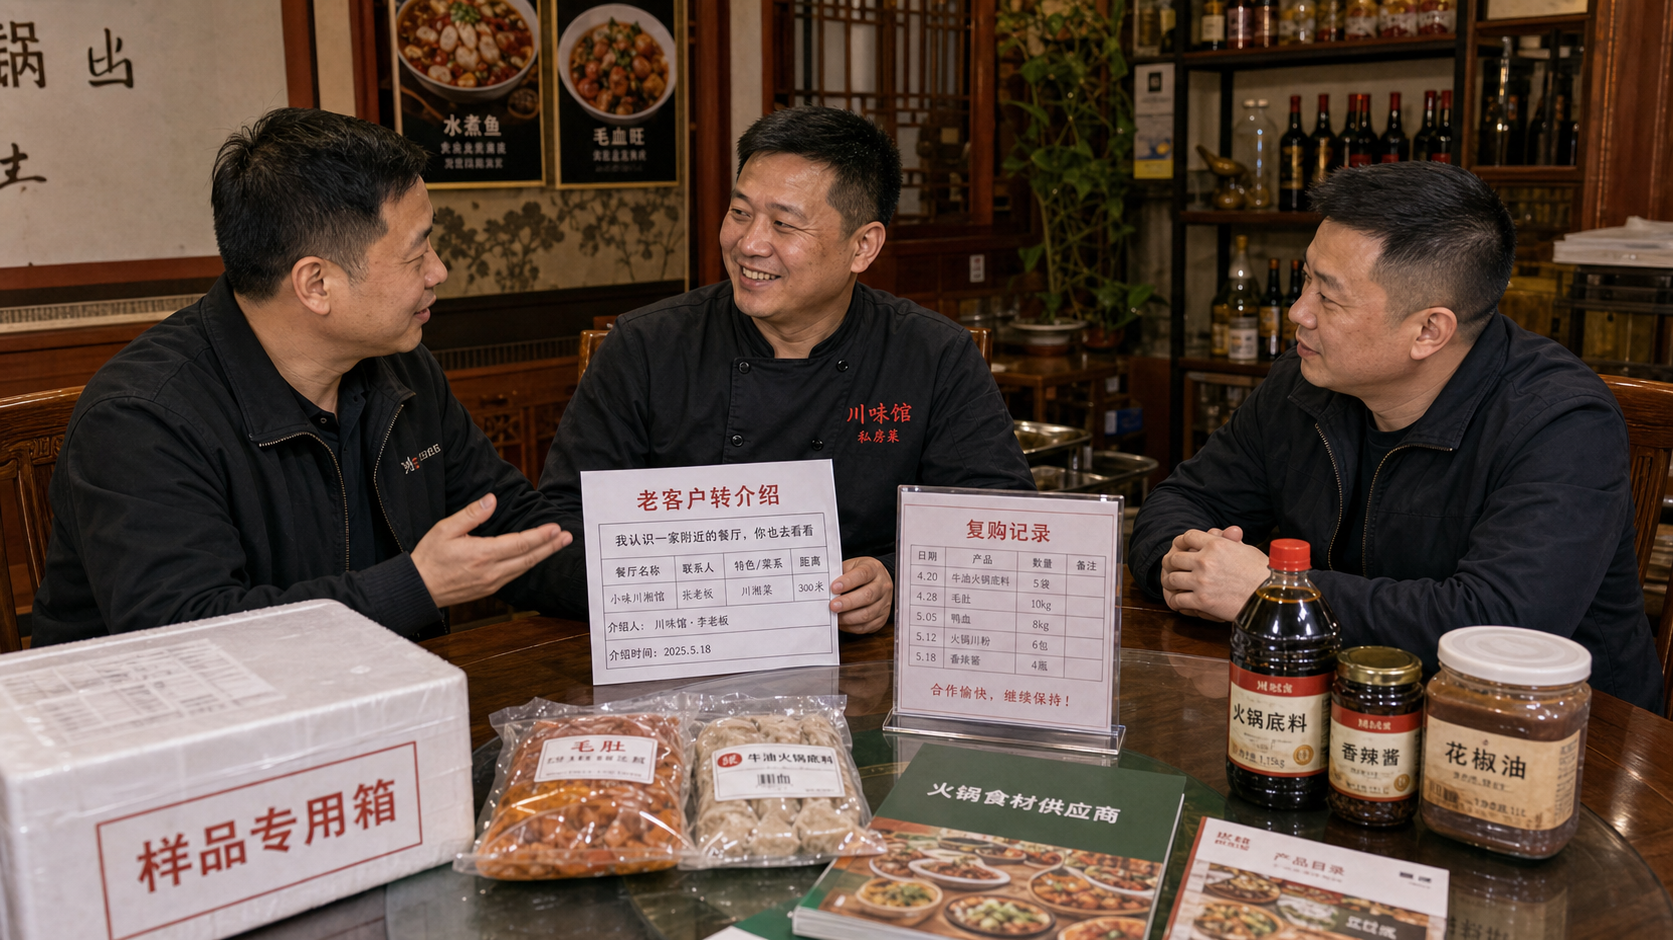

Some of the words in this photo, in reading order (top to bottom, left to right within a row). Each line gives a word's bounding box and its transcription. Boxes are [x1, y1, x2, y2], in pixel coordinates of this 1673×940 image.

[443, 114, 503, 138] 水煮鱼
[593, 127, 645, 147] 毛血旺
[846, 402, 912, 425] 川味馆
[857, 428, 900, 444] 私房菜
[636, 484, 780, 512] 老客户转介绍
[615, 524, 814, 547] 我认识一家附近的餐厅，你也去看看
[966, 519, 1051, 543] 复购记录
[615, 564, 661, 578] 餐厅名称
[682, 561, 714, 574] 联系人
[799, 555, 821, 568] 距离
[917, 551, 938, 562] 日期
[972, 553, 993, 565] 产品
[1032, 557, 1053, 569] 数量
[1076, 560, 1097, 572] 备注
[917, 572, 938, 582] 4.20
[951, 573, 1010, 587] 牛油火锅底料
[682, 587, 714, 601] 张老板
[798, 581, 825, 593] 300米
[916, 592, 938, 602] 4.28
[951, 593, 971, 604] 毛肚
[1031, 599, 1052, 611] 10kg
[916, 612, 937, 622] 5.05
[1032, 619, 1050, 632] 8kg
[663, 644, 712, 657] 2025.5.18
[916, 632, 937, 642] 5.12
[1032, 640, 1049, 651] 6包
[915, 652, 937, 662] 5.18
[1233, 703, 1307, 733] 火锅底料
[570, 739, 627, 753] 毛肚
[1341, 742, 1400, 767] 香辣酱
[747, 752, 834, 765] 牛油火锅底料
[1445, 740, 1527, 780] 花椒油
[926, 781, 1122, 825] 火锅食材供应商
[136, 777, 397, 894] 样品专用箱
[1273, 852, 1346, 877] 产品目录
